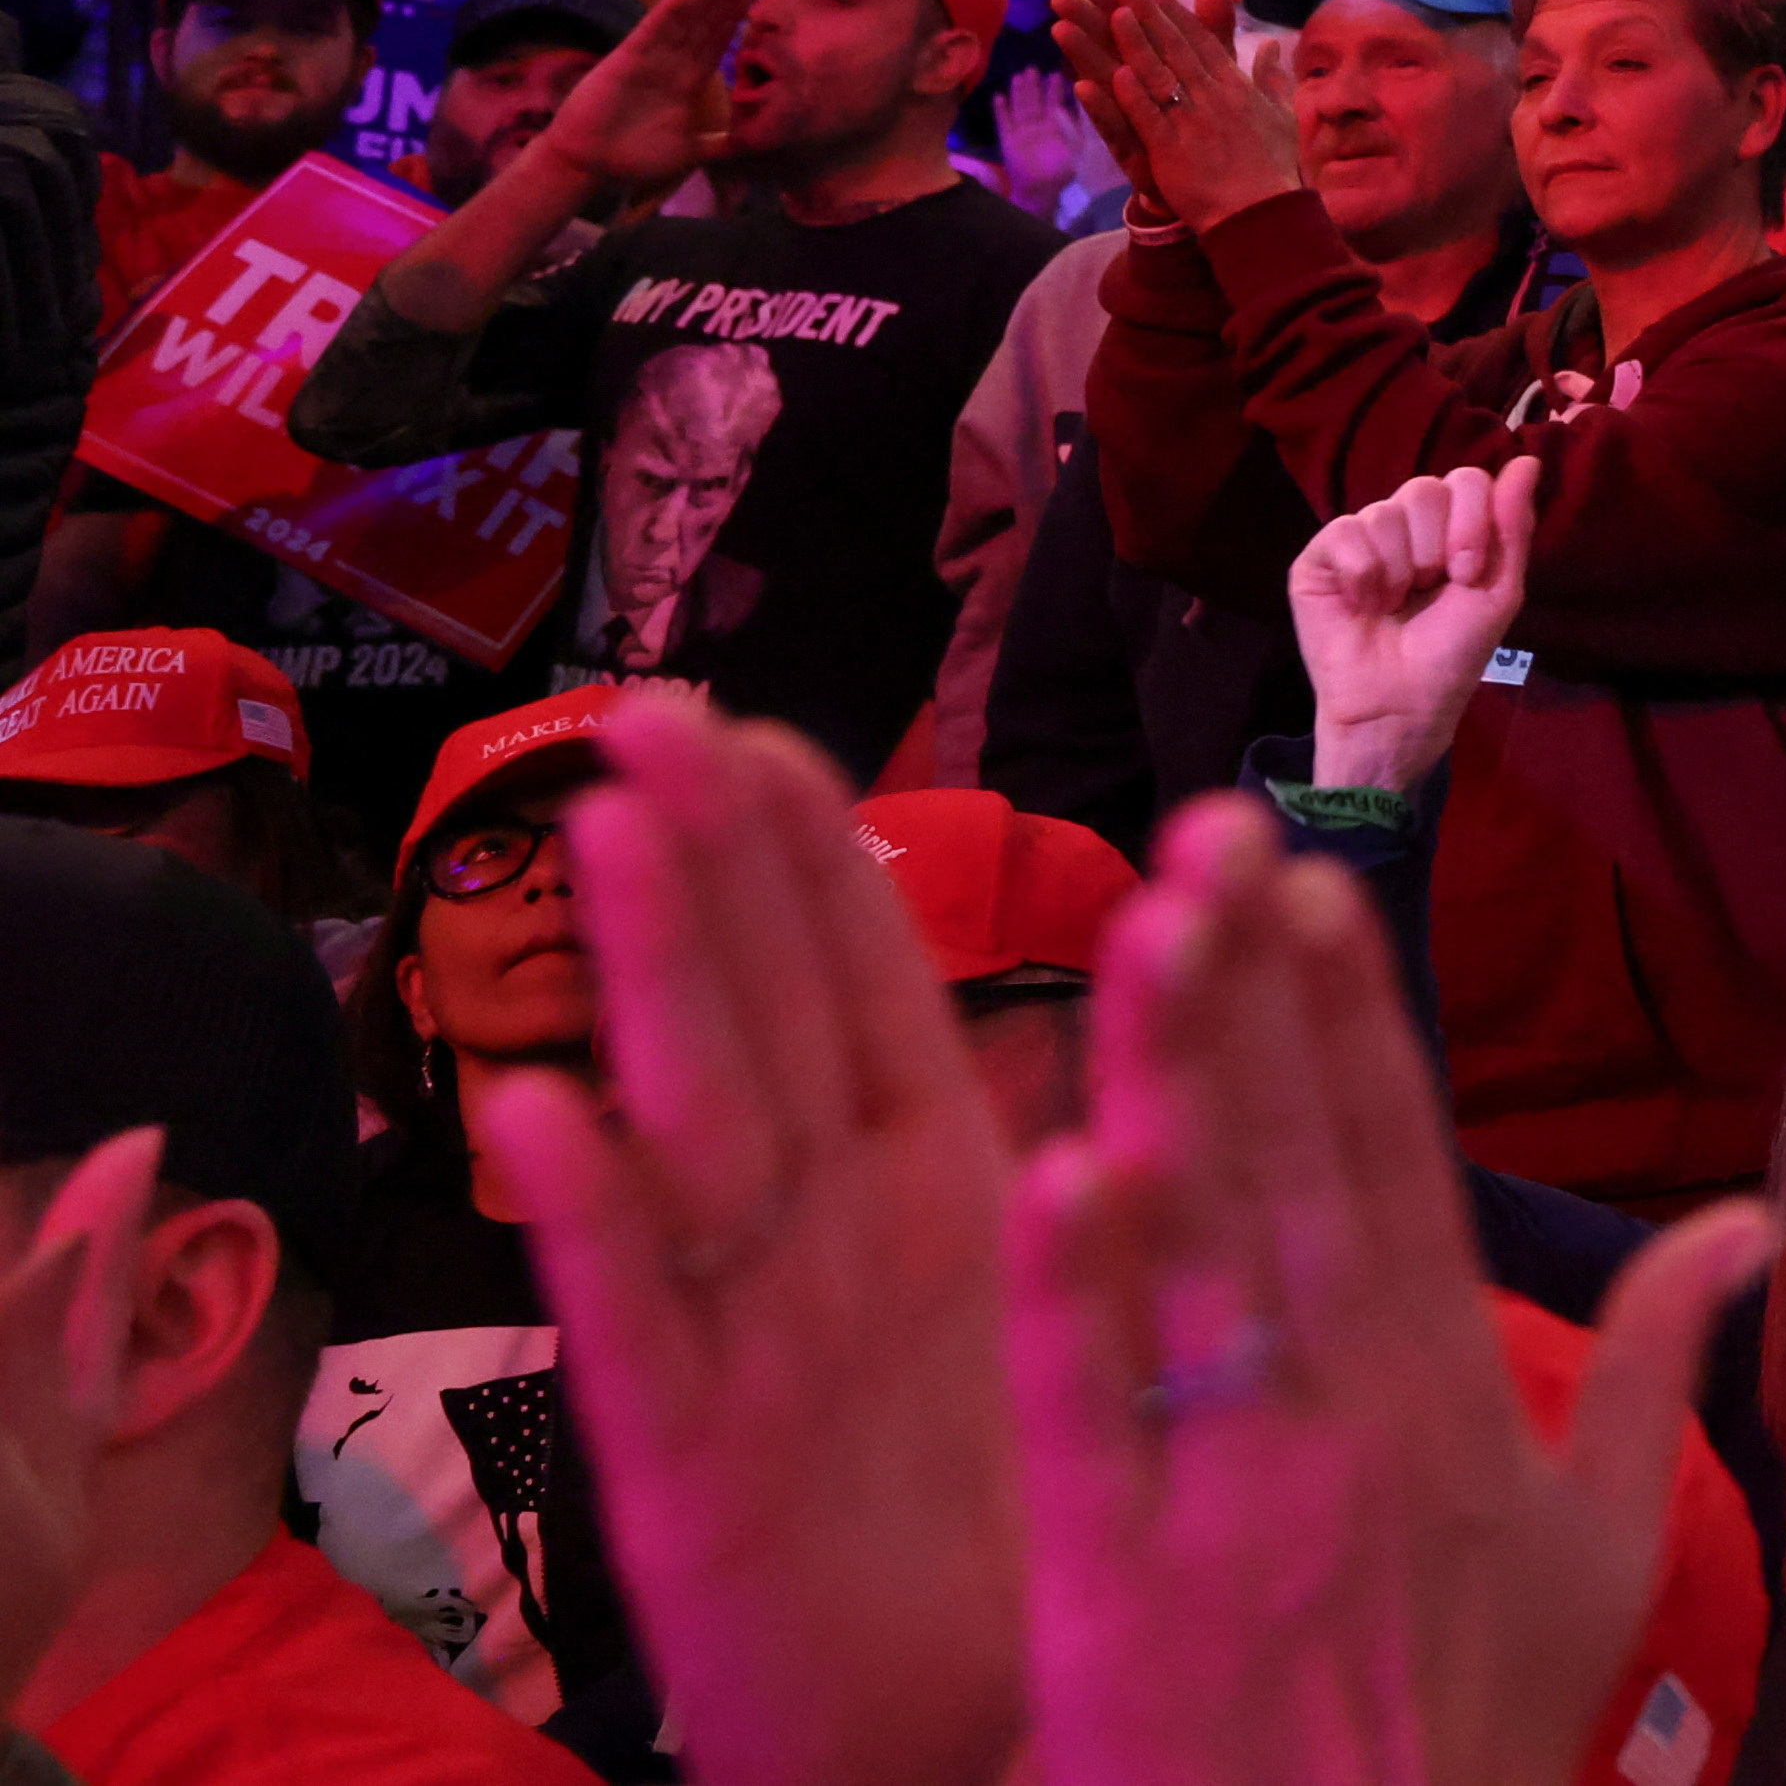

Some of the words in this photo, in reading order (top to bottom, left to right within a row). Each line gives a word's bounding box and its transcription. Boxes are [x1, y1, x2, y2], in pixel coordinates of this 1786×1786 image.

[611, 276, 696, 324] MY
[47, 646, 186, 682] AMERICA
[56, 682, 162, 718] AGAIN
[482, 716, 573, 759] MAKE
